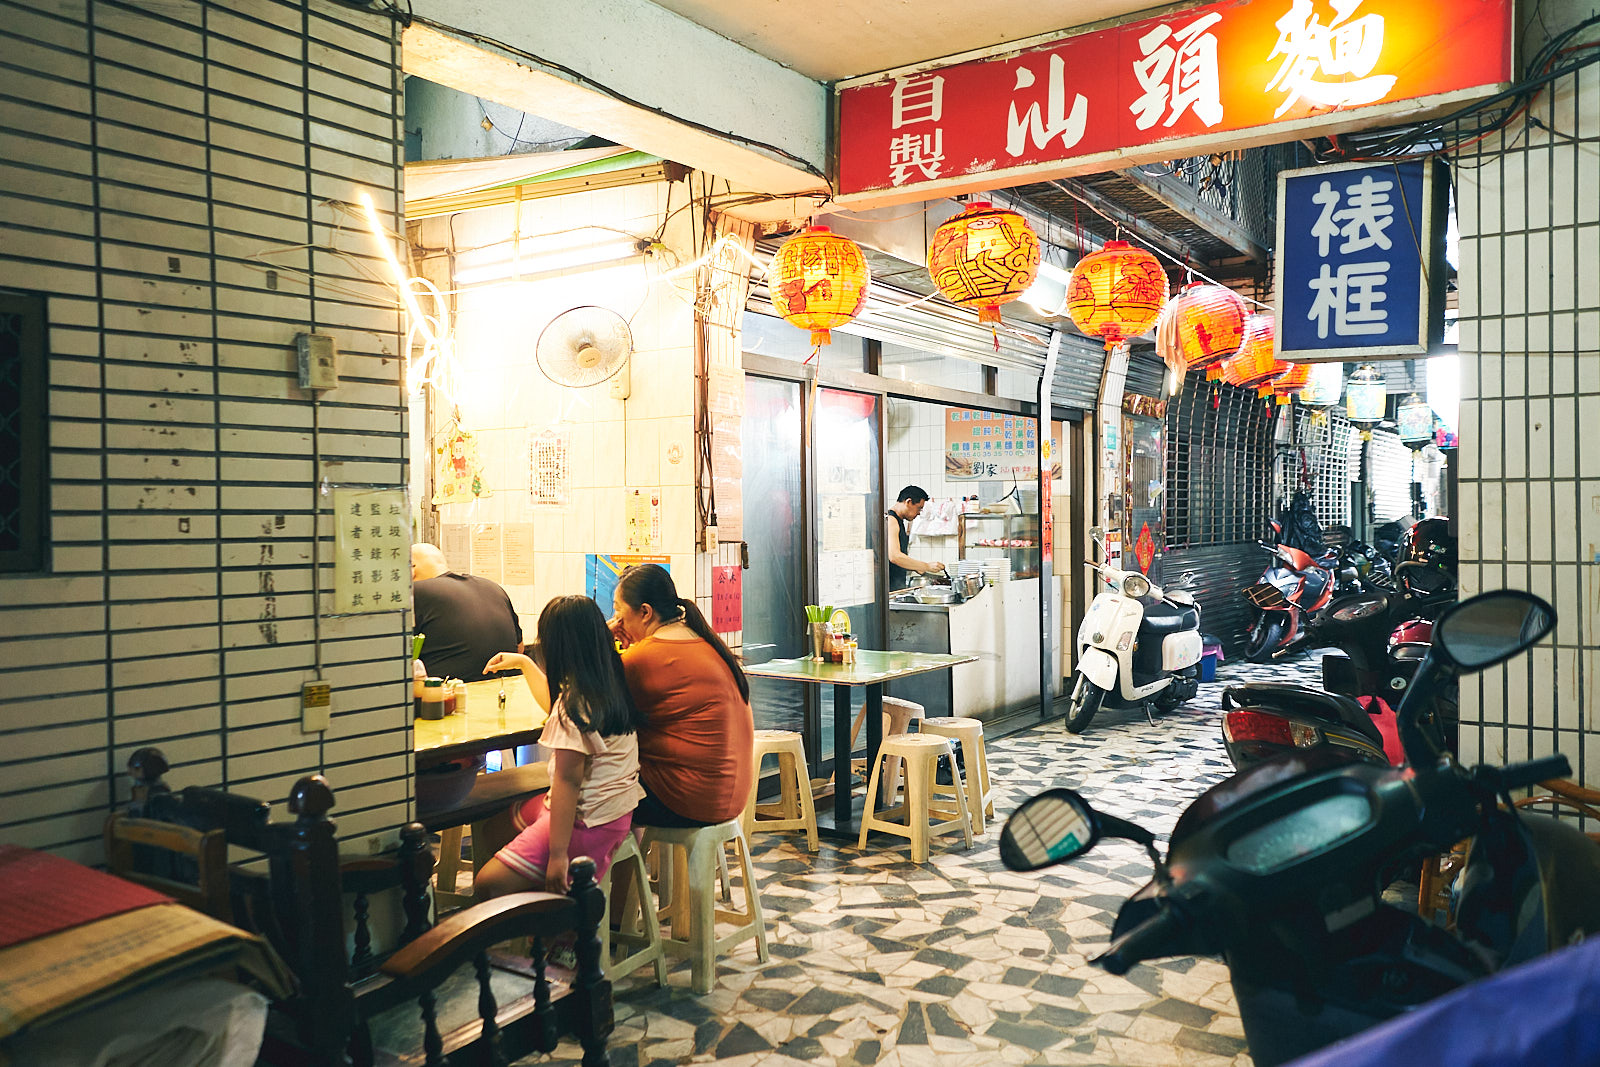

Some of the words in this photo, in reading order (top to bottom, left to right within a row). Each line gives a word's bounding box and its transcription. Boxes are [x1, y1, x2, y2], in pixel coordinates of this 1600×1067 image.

[889, 73, 945, 186] 自製
[1006, 0, 1397, 157] 汕頭麵
[1308, 176, 1394, 339] 裱框
[973, 461, 998, 477] 劉家
[351, 502, 364, 606] 違者要罰款
[370, 503, 383, 605] 監視錄影中
[388, 503, 402, 603] 垃圾不落地
